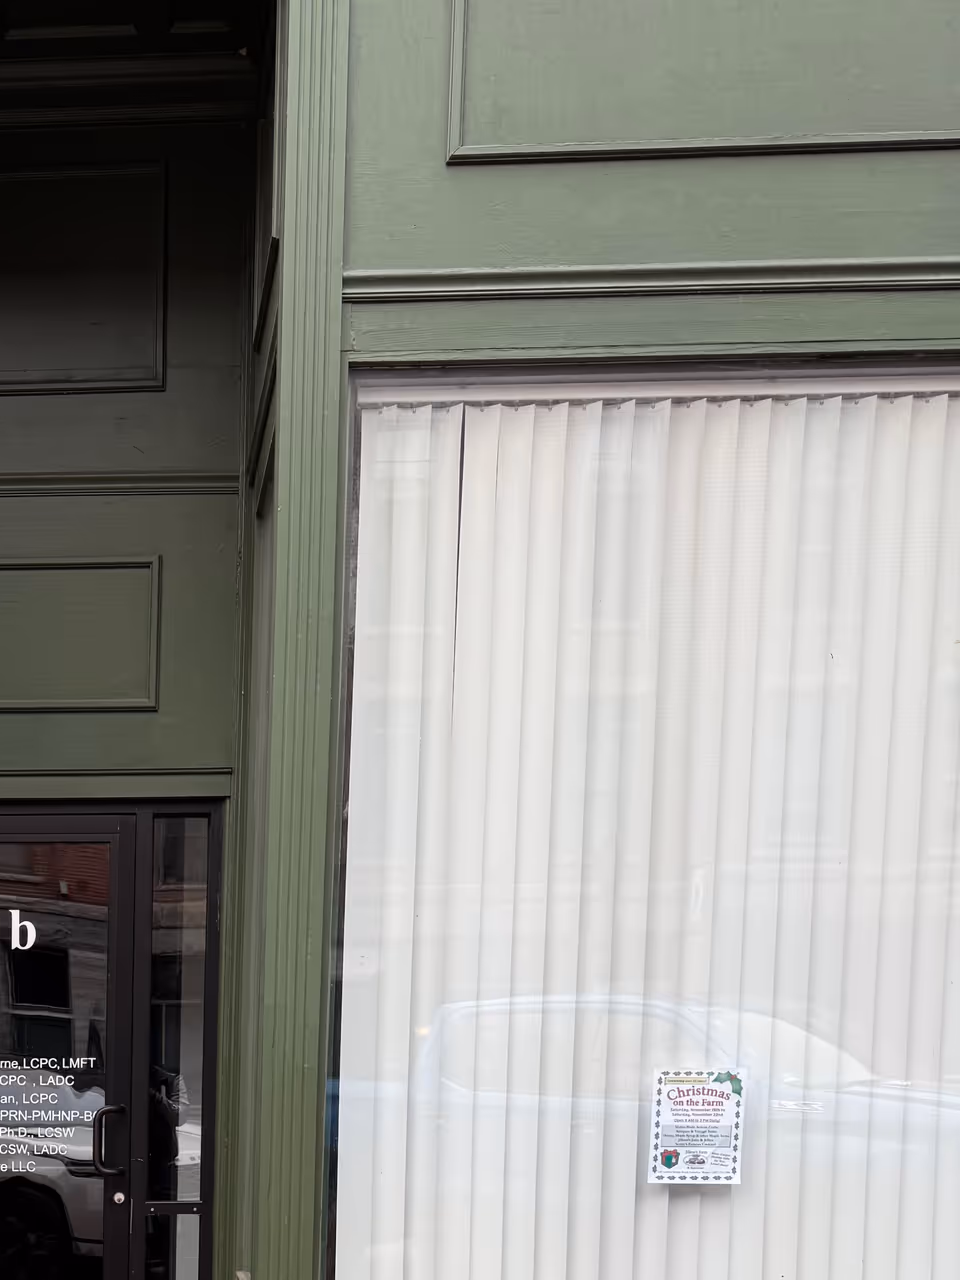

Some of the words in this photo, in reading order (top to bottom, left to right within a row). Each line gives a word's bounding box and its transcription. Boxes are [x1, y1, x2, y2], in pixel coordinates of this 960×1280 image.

[9, 909, 37, 950] b
[23, 1058, 60, 1070] LCPC,
[62, 1057, 97, 1069] LMFT
[40, 1075, 75, 1086] LADC
[22, 1093, 58, 1104] LCPC
[667, 1085, 731, 1101] Christmas
[0, 1127, 34, 1138] Ph.D.,
[38, 1127, 75, 1138] LCSW
[34, 1144, 68, 1155] LADC
[11, 1161, 36, 1172] LLC
